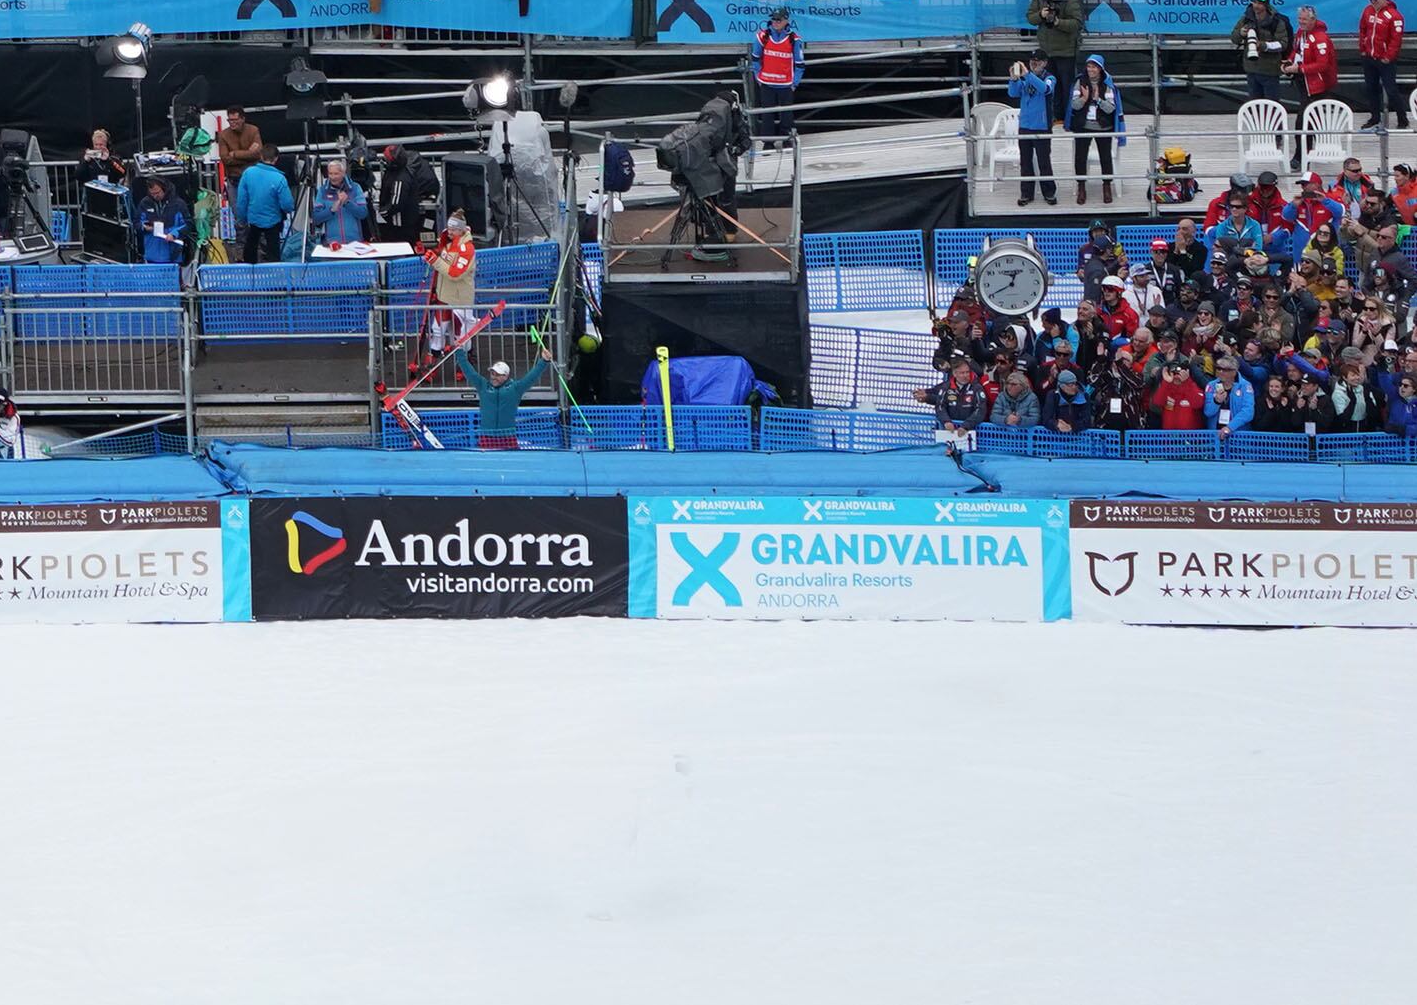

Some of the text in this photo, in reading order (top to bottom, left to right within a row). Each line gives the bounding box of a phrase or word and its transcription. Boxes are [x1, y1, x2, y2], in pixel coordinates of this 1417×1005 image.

[310, 2, 372, 17] ANDORR
[808, 4, 861, 17] Resorts
[1148, 11, 1220, 24] ANDORRA
[727, 21, 799, 33] ANDOA
[121, 506, 208, 518] PARKPIOLETS
[693, 500, 765, 511] GRANDVALIRA
[825, 500, 895, 512] GRANDVALIRA
[955, 502, 1028, 514] GRANDVALIRA
[1105, 506, 1196, 517] PARKPIOLETS
[1, 510, 88, 520] PARKPIOLETS
[1231, 508, 1321, 518] PARKPIOLETS
[354, 518, 594, 567] Andorra
[751, 533, 1029, 567] GRANDVALIRA
[406, 572, 594, 593] visitandorra.com
[756, 572, 913, 588] Grandvalira Resorts
[27, 582, 208, 601] Mountain Hotel &Spa
[1257, 584, 1342, 601] Mountain
[1346, 584, 1392, 600] Hotel
[757, 593, 839, 608] ANDORRA
